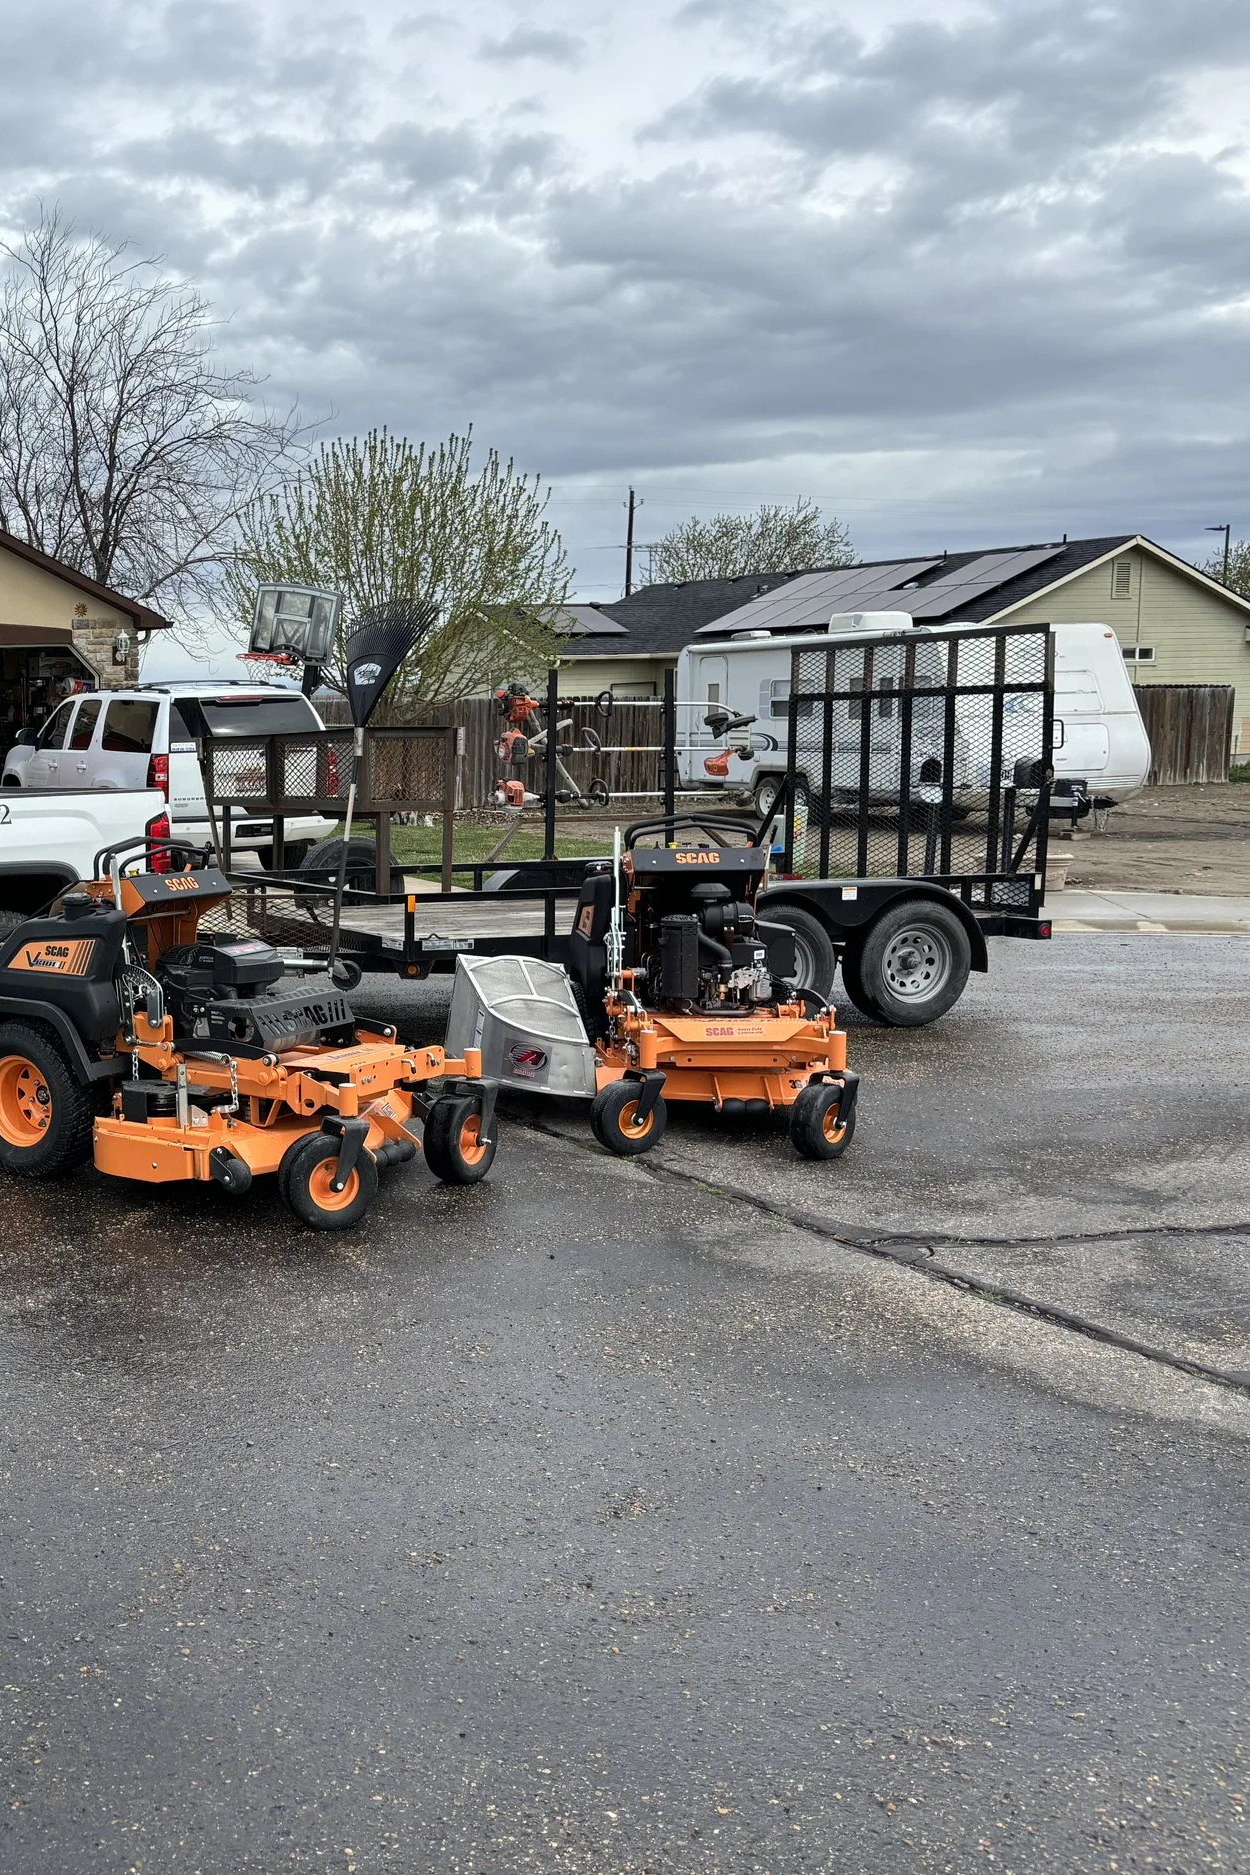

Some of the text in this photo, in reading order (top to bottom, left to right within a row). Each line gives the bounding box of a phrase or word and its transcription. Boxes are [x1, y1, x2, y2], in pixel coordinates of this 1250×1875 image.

[675, 852, 720, 864] SCAG
[164, 876, 200, 891] SCAG
[44, 945, 70, 958] SCAG
[282, 1001, 329, 1033] SCAG
[705, 1026, 735, 1037] SCAG
